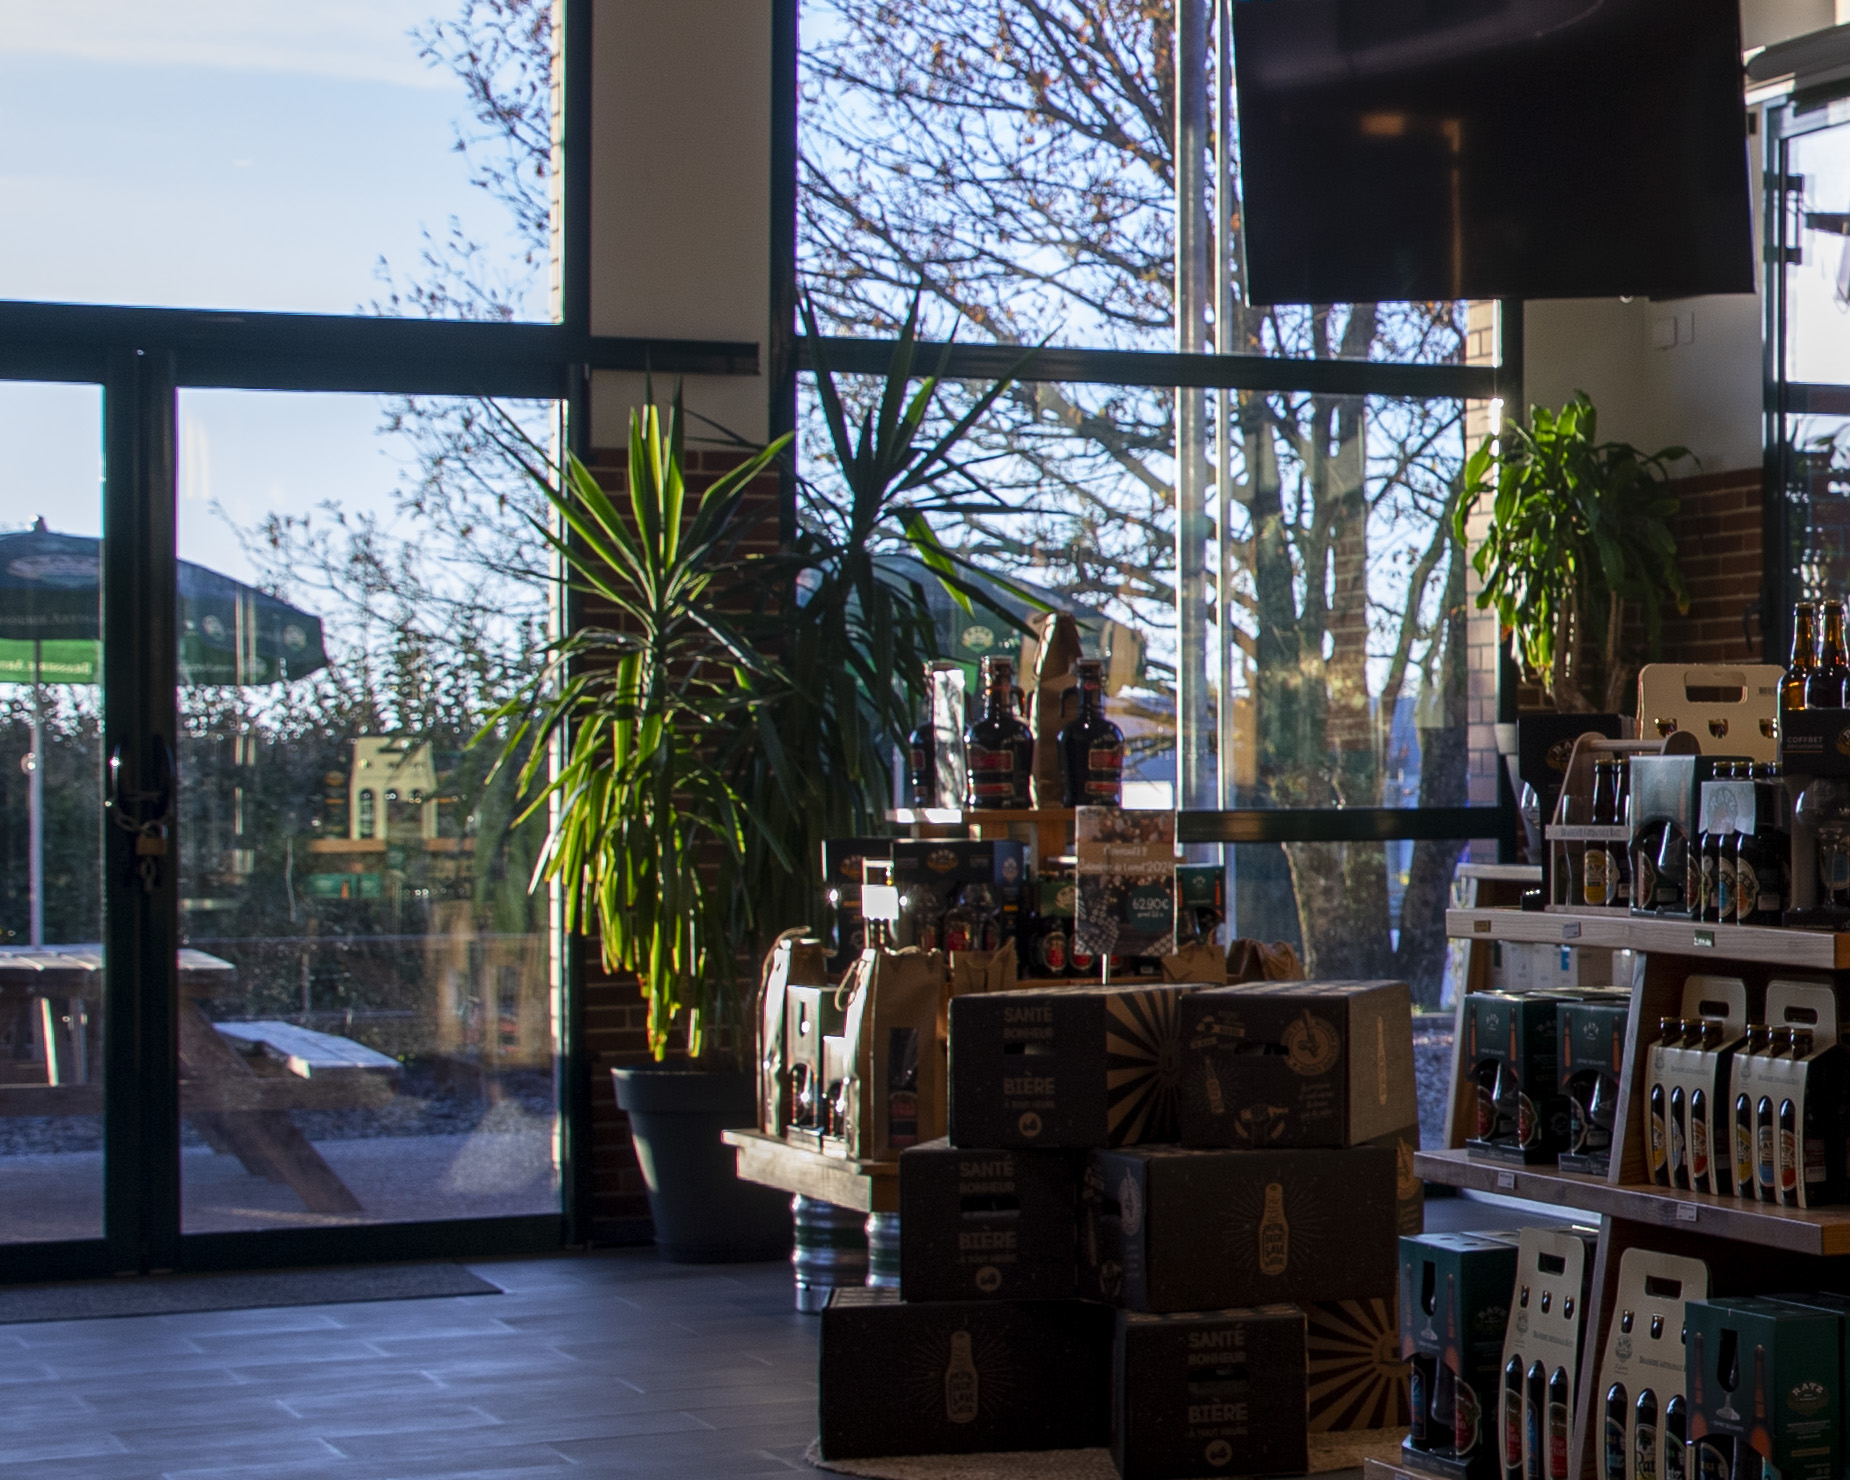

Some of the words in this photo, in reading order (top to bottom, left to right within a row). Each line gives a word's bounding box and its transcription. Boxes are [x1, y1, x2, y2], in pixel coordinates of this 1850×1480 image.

[1004, 1001, 1053, 1023] SANTÉ
[1004, 1071, 1055, 1094] BIÈRE
[1188, 1322, 1245, 1348] SANTÉ
[1188, 1398, 1248, 1423] BIÈRE
